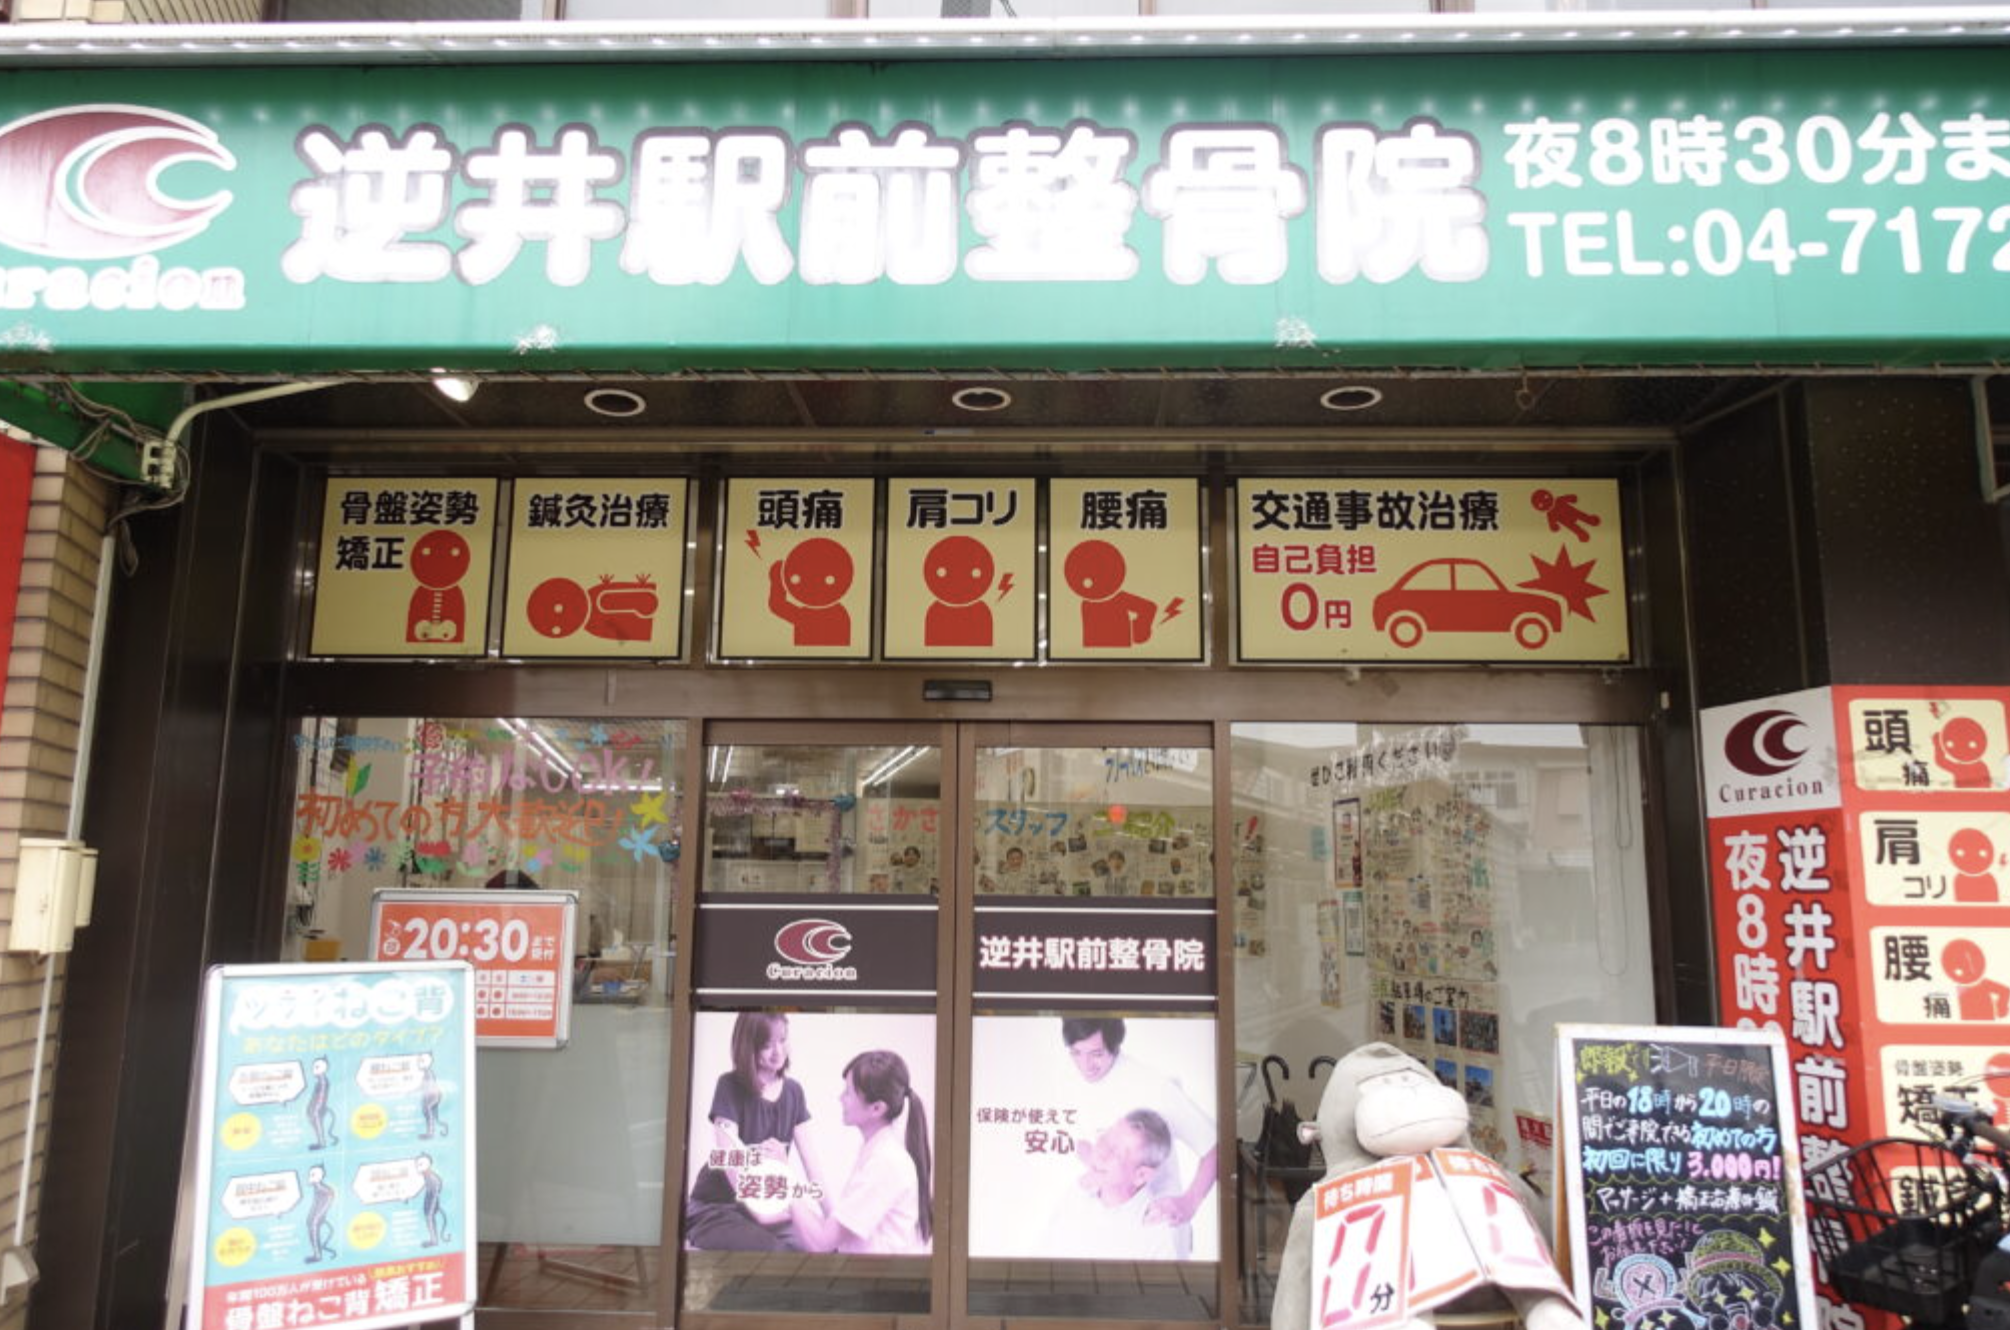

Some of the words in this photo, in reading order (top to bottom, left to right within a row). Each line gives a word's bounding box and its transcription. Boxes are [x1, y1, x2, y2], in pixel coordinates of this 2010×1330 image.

[281, 117, 1490, 287] 逆井駅前整骨院
[0, 254, 246, 311] racion
[341, 489, 480, 526] 骨盤姿勢
[528, 492, 671, 529] 鍼灸治療
[757, 488, 845, 530] 頭痛
[906, 487, 1018, 529] 肩コリ
[1080, 488, 1168, 531] 腰痛
[1251, 489, 1500, 532] 交通事故治療
[335, 535, 405, 571] 矯正
[1252, 543, 1378, 576] 自己負担
[1280, 581, 1353, 632] 0円
[1718, 777, 1824, 805] Curacion
[402, 916, 530, 963] 20:30
[978, 935, 1206, 973] 逆井駅前整骨院
[766, 962, 858, 981] Curacion
[976, 1106, 1077, 1126] 保険が使えて
[708, 1148, 762, 1170] 健康は
[1024, 1128, 1076, 1155] 安心
[736, 1173, 824, 1201] 姿勢から
